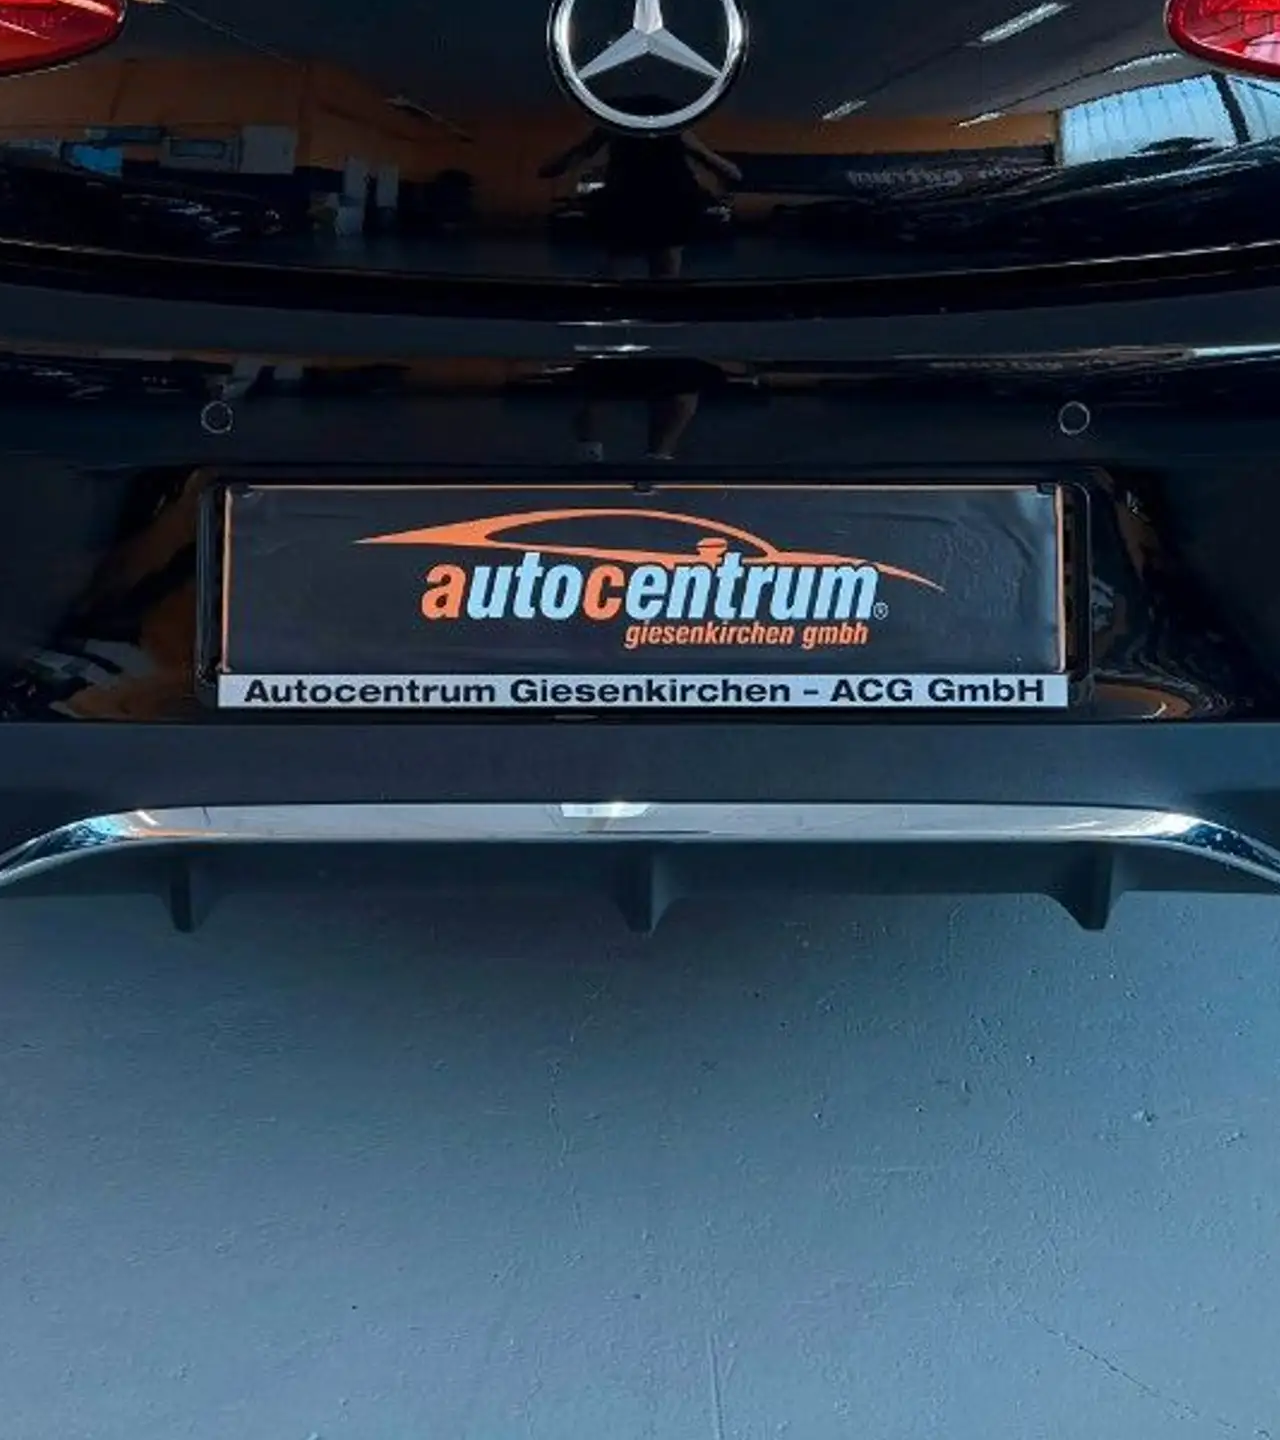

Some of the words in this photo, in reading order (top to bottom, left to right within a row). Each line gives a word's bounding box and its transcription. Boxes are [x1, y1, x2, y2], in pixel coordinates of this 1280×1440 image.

[421, 552, 878, 620] autocentrum
[624, 621, 794, 649] giesenkirchen
[802, 621, 869, 650] gmbh
[244, 678, 496, 704] Autocentrum
[510, 677, 791, 704] Giesenkirchen
[830, 677, 913, 704] ACG
[928, 677, 1044, 704] GmbH
